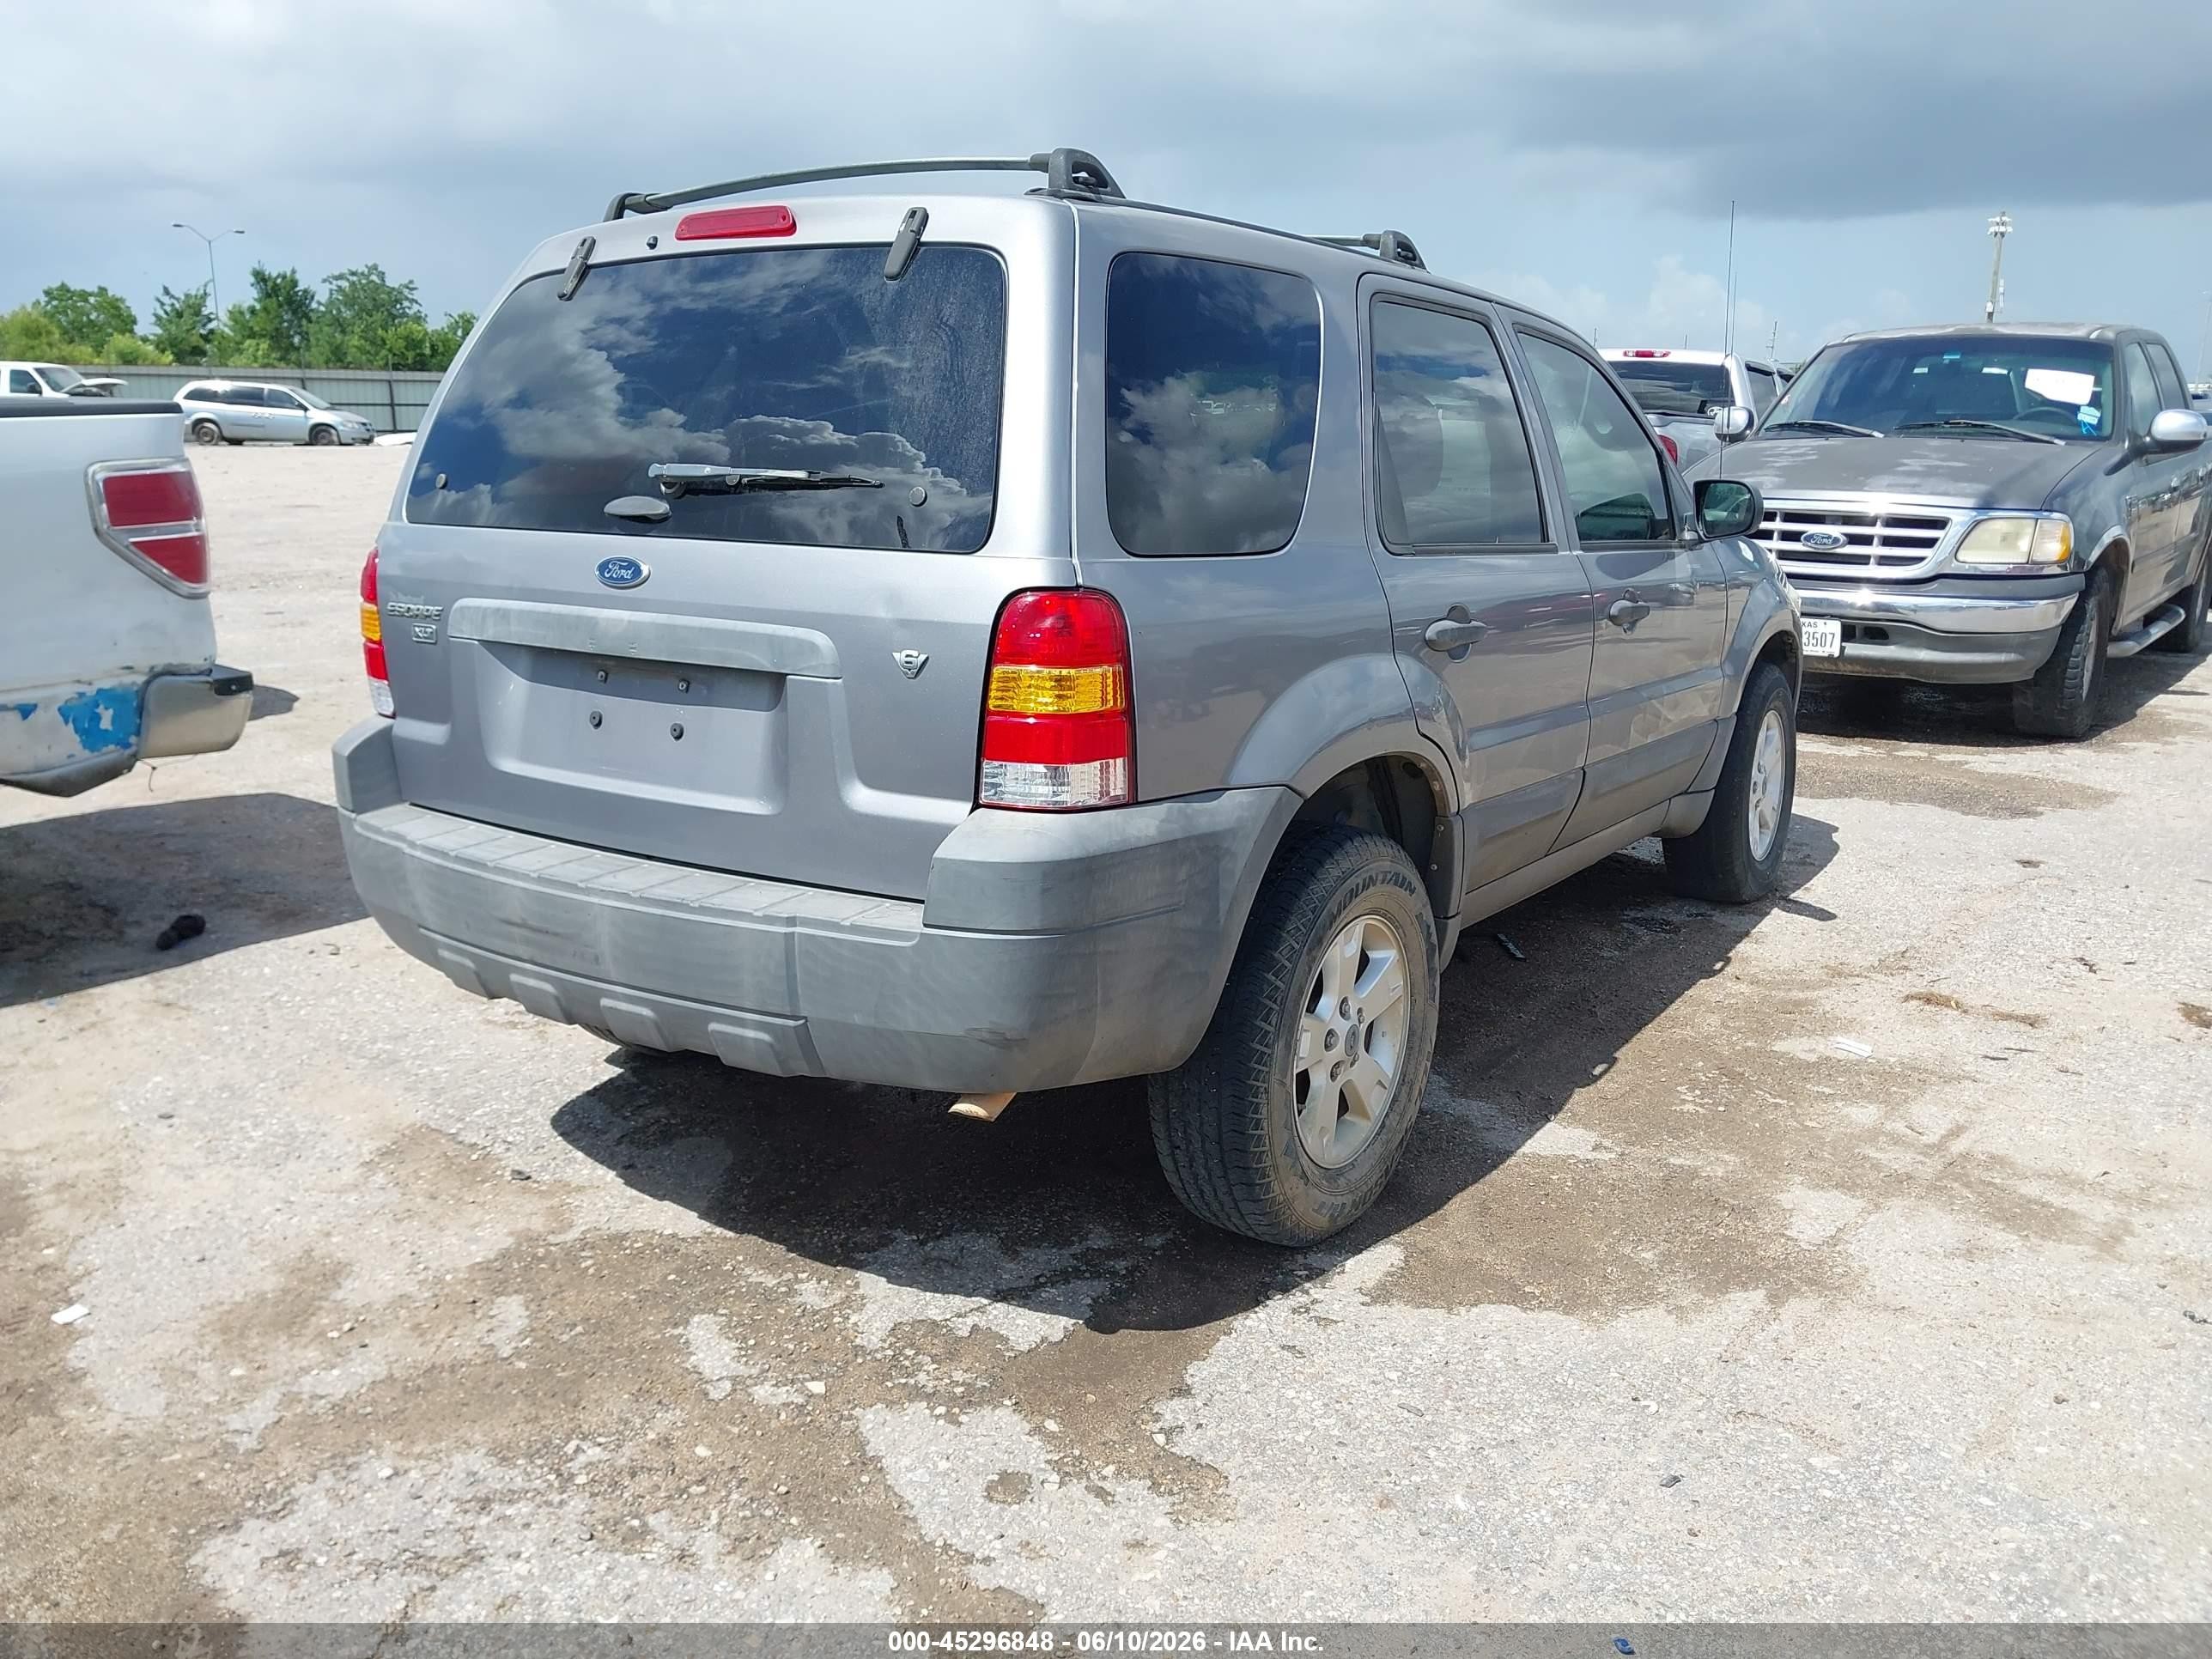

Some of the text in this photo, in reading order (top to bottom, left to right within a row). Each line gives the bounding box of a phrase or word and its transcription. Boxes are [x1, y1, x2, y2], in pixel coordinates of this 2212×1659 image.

[1811, 533, 1833, 544] Ford
[604, 560, 635, 580] Ford
[387, 602, 443, 621] ESCAPE
[1803, 631, 1835, 648] 3507
[1331, 870, 1416, 924] MOUNTAIN
